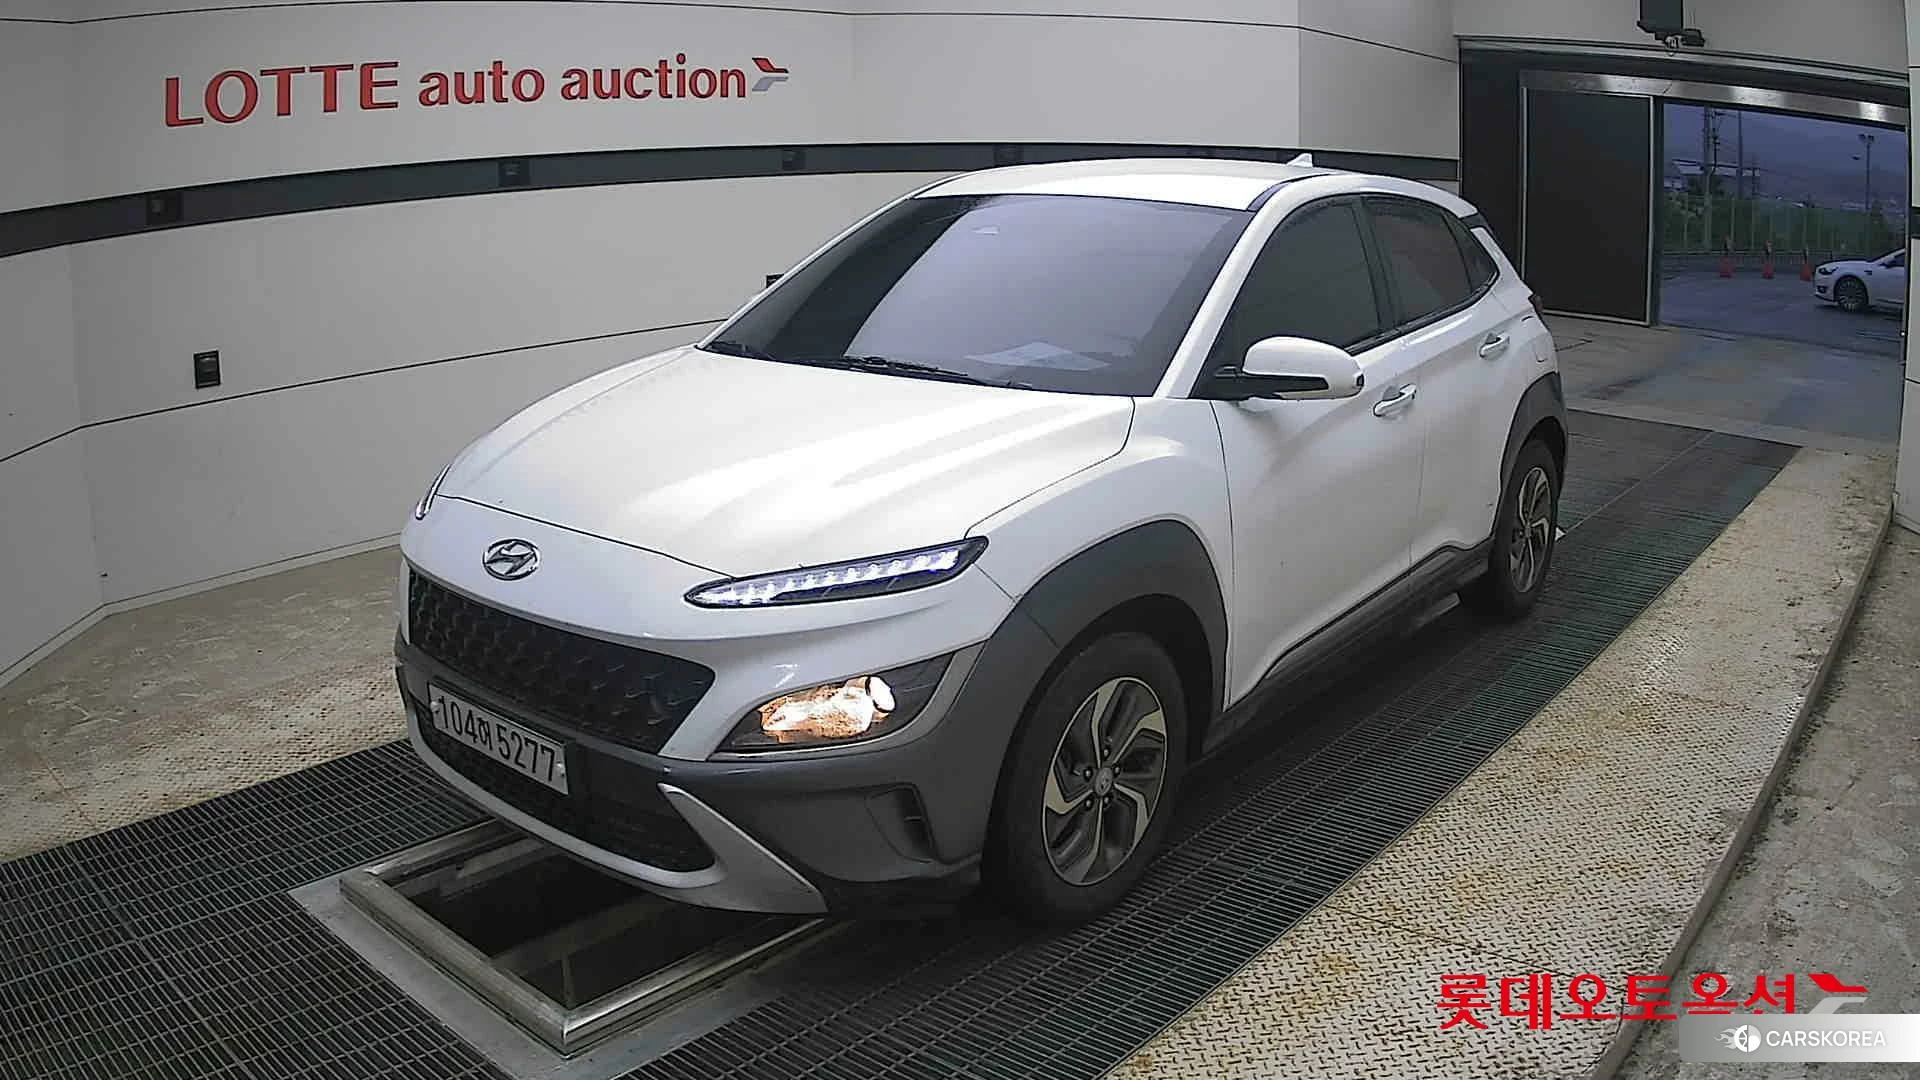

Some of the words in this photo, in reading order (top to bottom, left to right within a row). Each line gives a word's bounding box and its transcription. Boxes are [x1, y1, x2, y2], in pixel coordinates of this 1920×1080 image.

[165, 61, 399, 127] LOTTE
[418, 60, 545, 107] auto
[560, 52, 747, 101] auction
[495, 723, 555, 782] 5277
